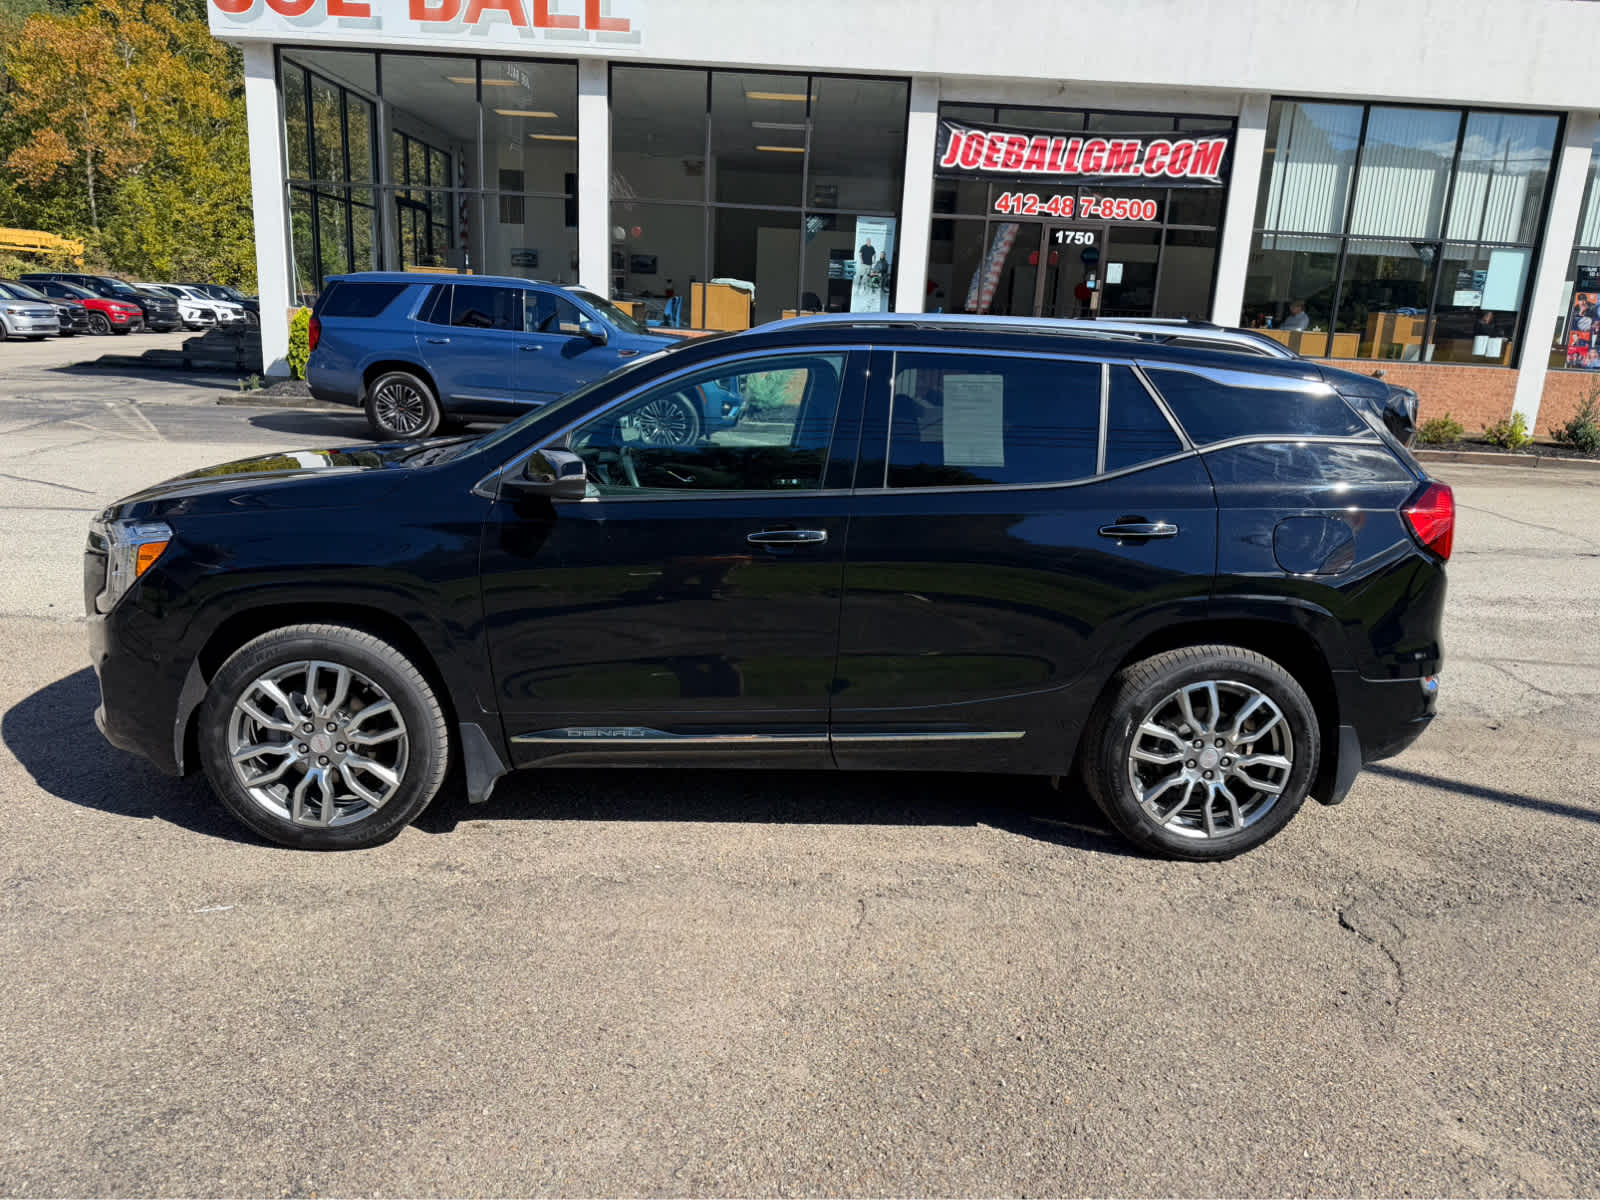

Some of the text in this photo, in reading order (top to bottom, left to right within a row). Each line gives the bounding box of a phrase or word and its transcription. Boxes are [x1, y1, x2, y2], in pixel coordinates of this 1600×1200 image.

[941, 131, 1227, 177] JOEBALLGM.COM
[1056, 231, 1094, 244] 1750
[567, 727, 646, 737] DENALI
